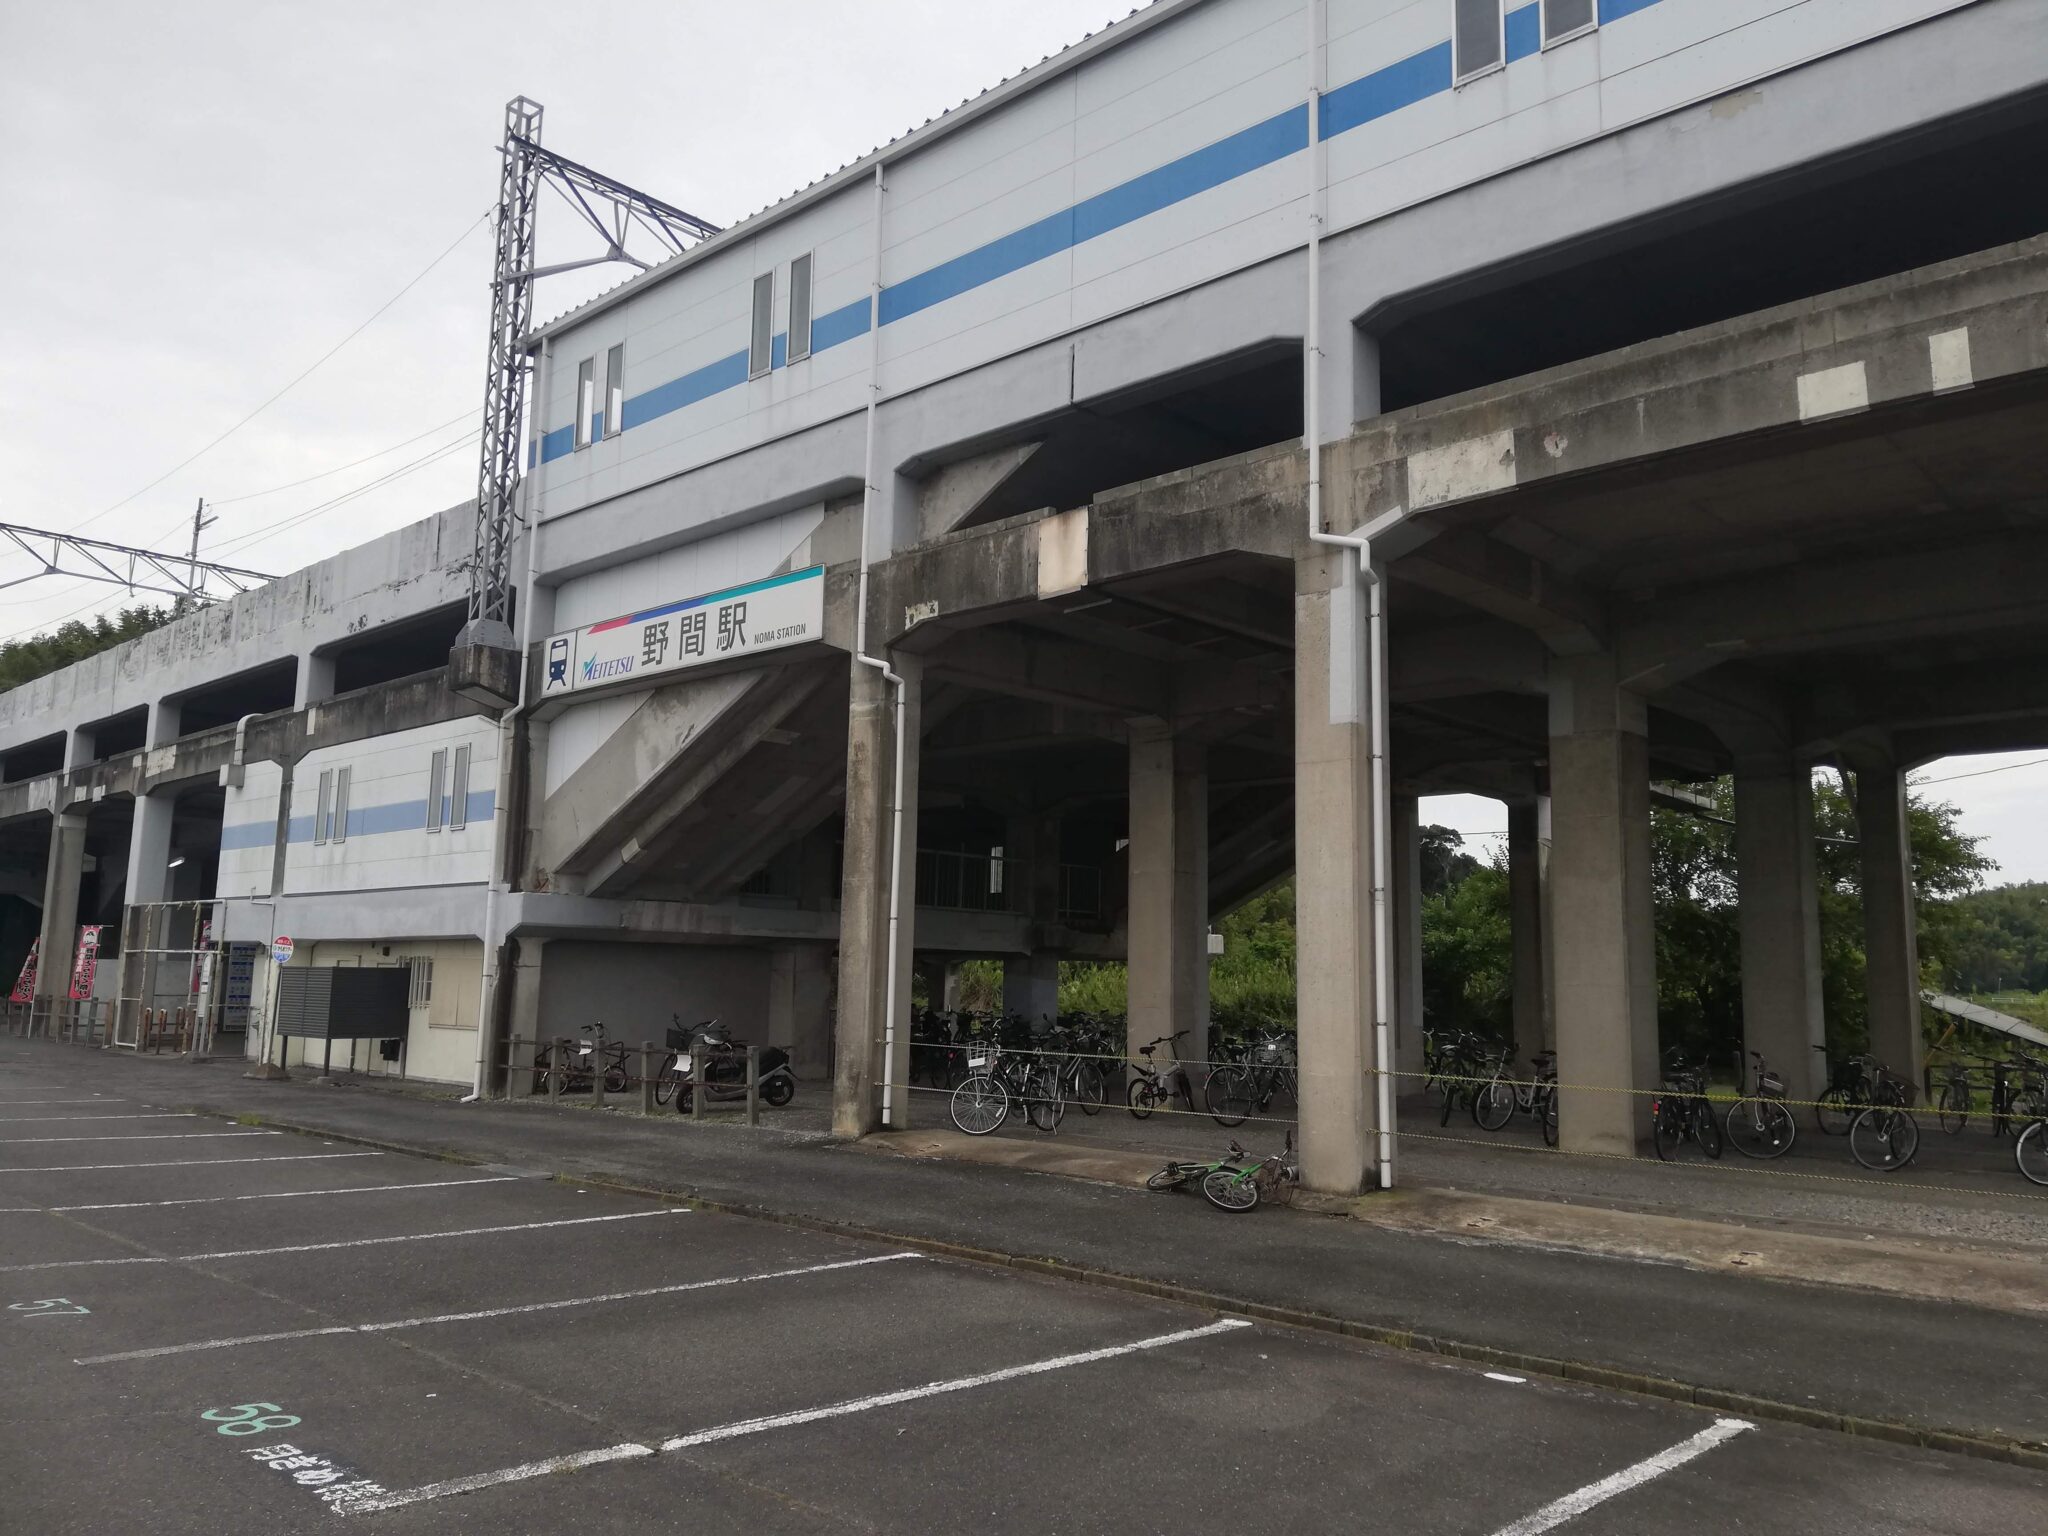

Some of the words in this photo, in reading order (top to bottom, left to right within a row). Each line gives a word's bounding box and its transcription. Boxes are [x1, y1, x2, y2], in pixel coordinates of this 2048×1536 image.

[641, 601, 748, 667] 野間駅
[754, 630, 775, 645] NOMA
[776, 623, 807, 640] STATION
[580, 653, 635, 682] MEITETSU
[8, 1298, 92, 1318] 57
[201, 1402, 302, 1436] 58
